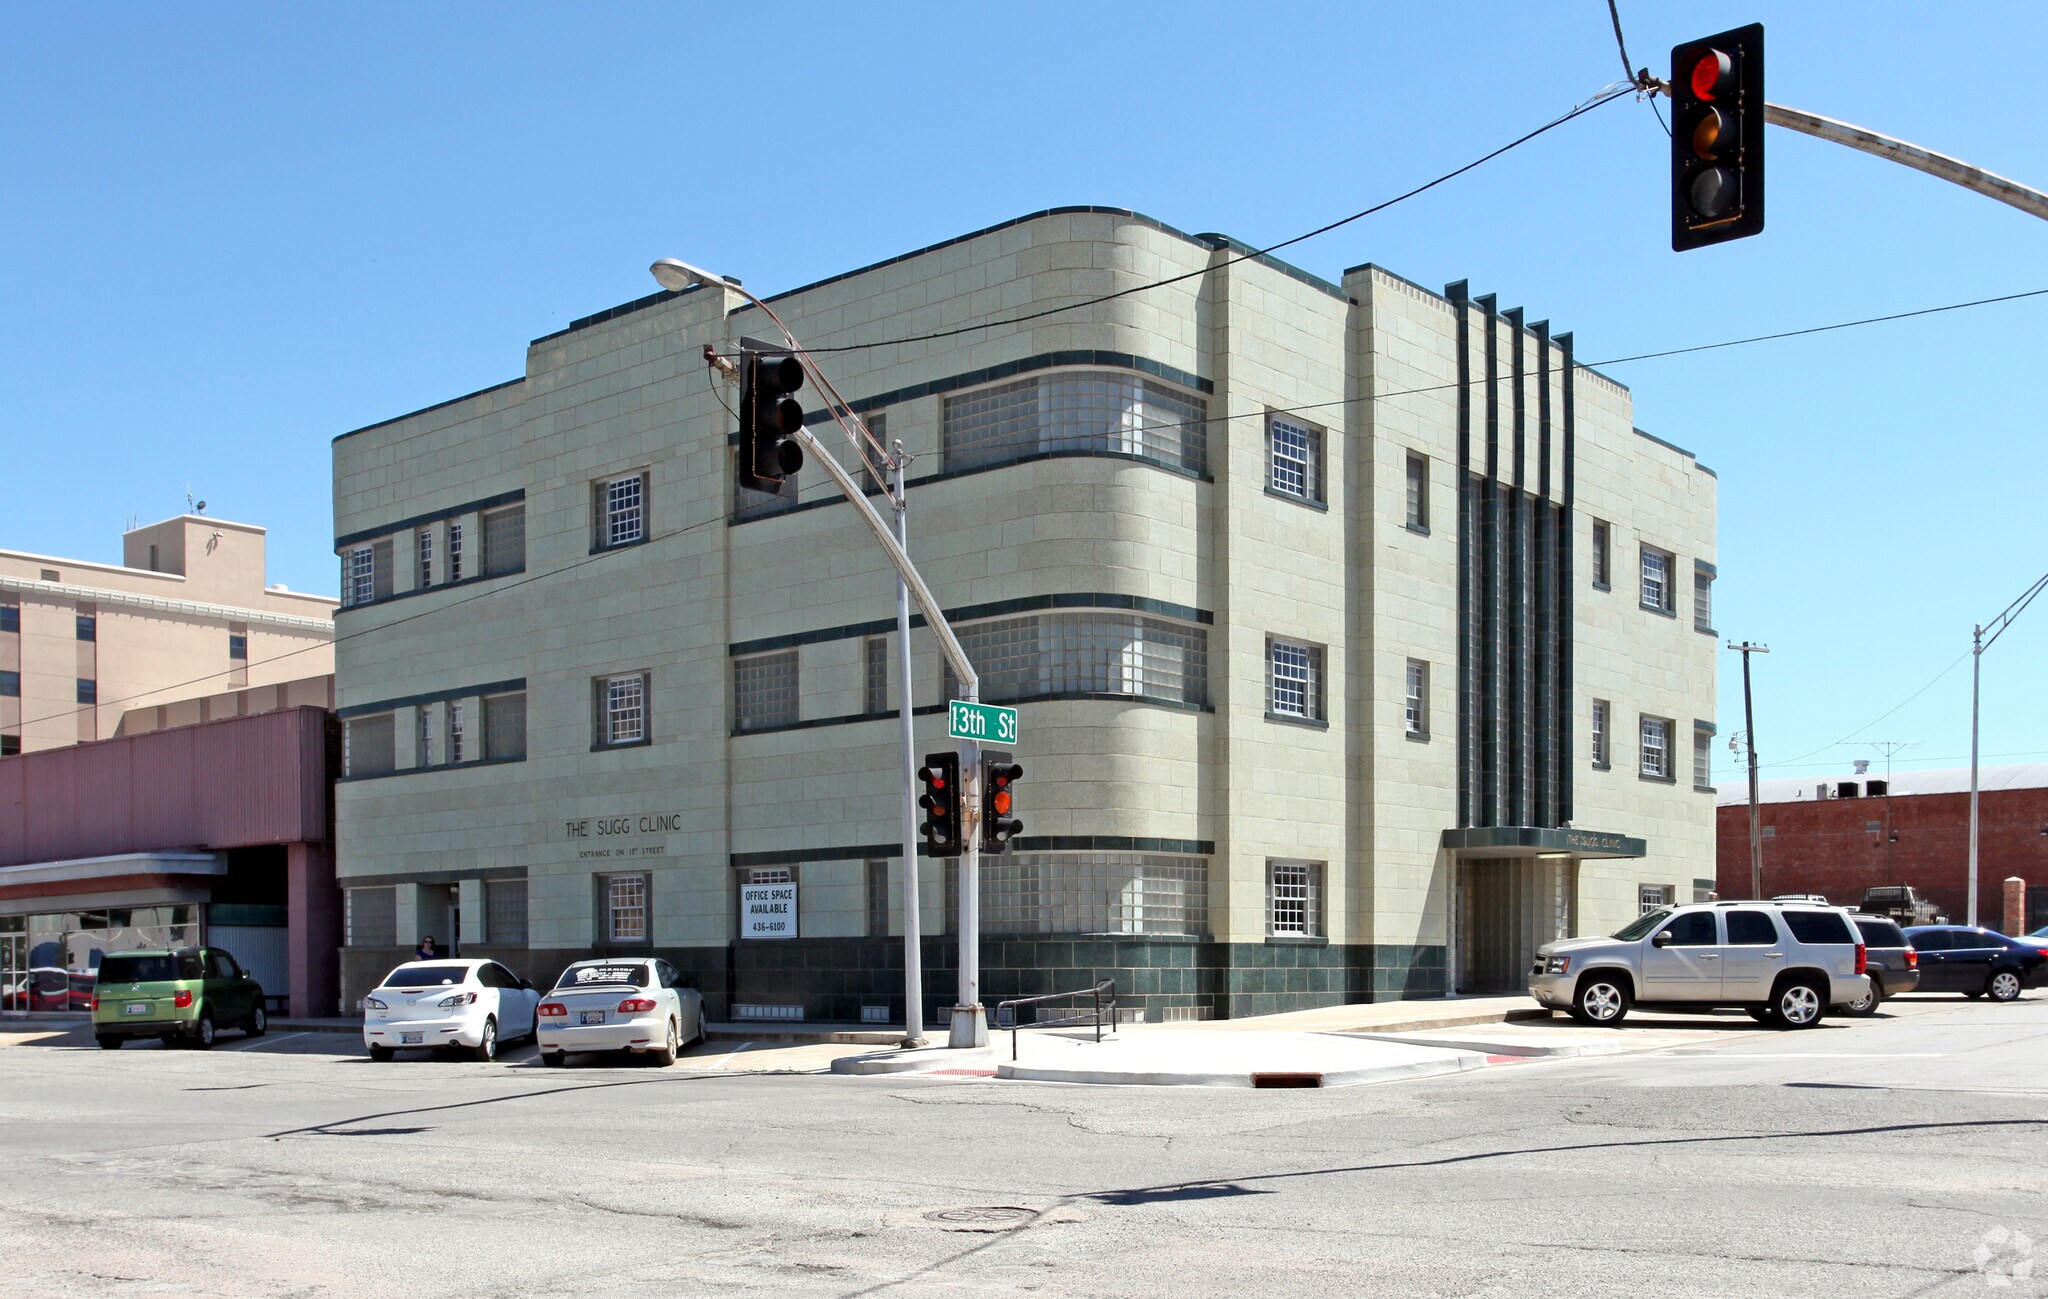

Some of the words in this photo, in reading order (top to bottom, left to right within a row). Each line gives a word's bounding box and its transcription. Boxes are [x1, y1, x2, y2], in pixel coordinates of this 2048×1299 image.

[952, 706, 986, 736] 13th
[998, 712, 1015, 739] St
[565, 821, 588, 838] THE
[597, 818, 630, 836] SUGG
[639, 814, 681, 833] CLINIC
[1567, 834, 1579, 846] THE
[1581, 836, 1599, 847] SUGG
[579, 849, 611, 859] ENTRANCE
[615, 848, 625, 857] ON
[642, 846, 665, 855] STREET
[745, 890, 769, 901] OFFICE
[771, 889, 793, 900] SPACE
[750, 903, 788, 914] AVAILABLE
[752, 921, 786, 932] 436-6100
